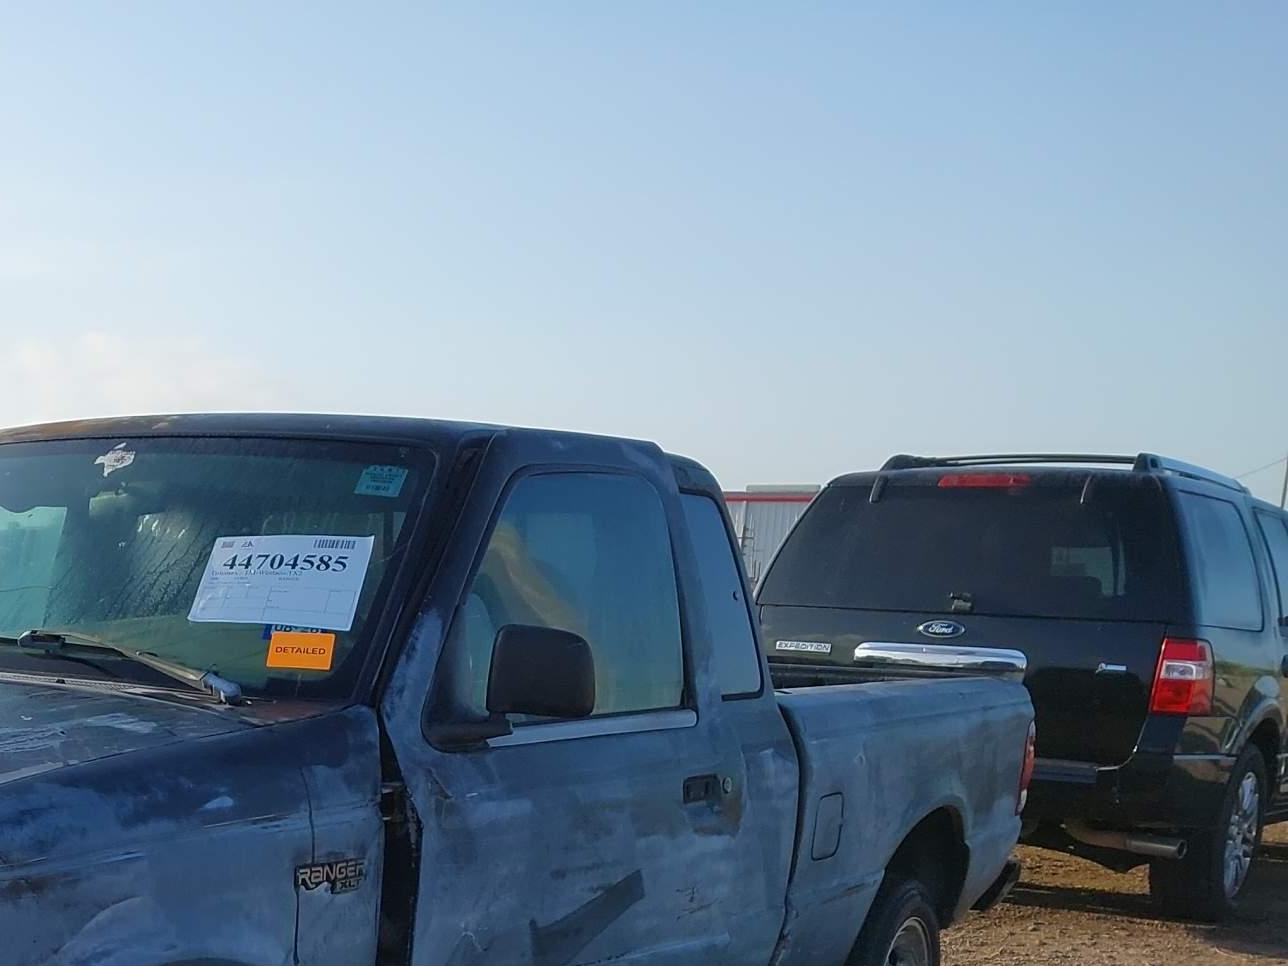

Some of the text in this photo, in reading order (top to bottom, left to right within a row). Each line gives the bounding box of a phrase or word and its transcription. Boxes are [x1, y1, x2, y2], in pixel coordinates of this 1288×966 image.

[223, 553, 350, 573] 44704585
[275, 646, 326, 655] DETAILED
[778, 641, 830, 651] EXPEDITION
